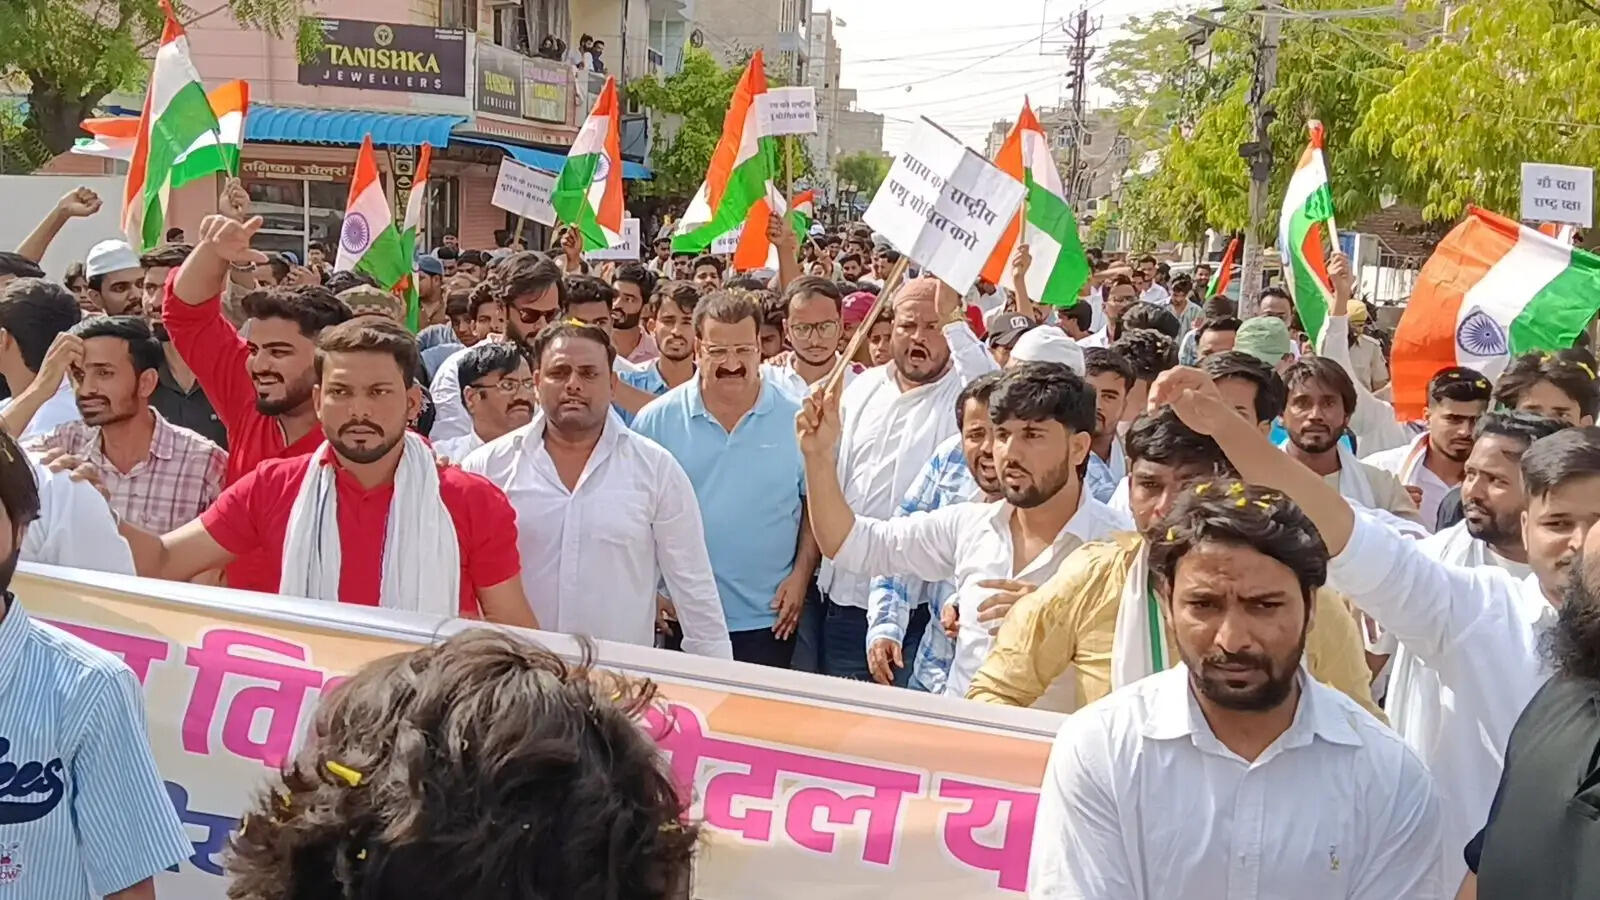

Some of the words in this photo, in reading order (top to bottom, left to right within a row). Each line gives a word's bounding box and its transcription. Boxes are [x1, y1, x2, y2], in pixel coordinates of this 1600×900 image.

[324, 44, 441, 74] TANISHKA
[323, 69, 443, 90] JEWELLERS
[242, 160, 296, 174] तनिष्का
[889, 179, 910, 207] पशु
[950, 221, 979, 251] करो
[950, 186, 998, 227] राष्ट्रीय
[0, 738, 64, 817] ees
